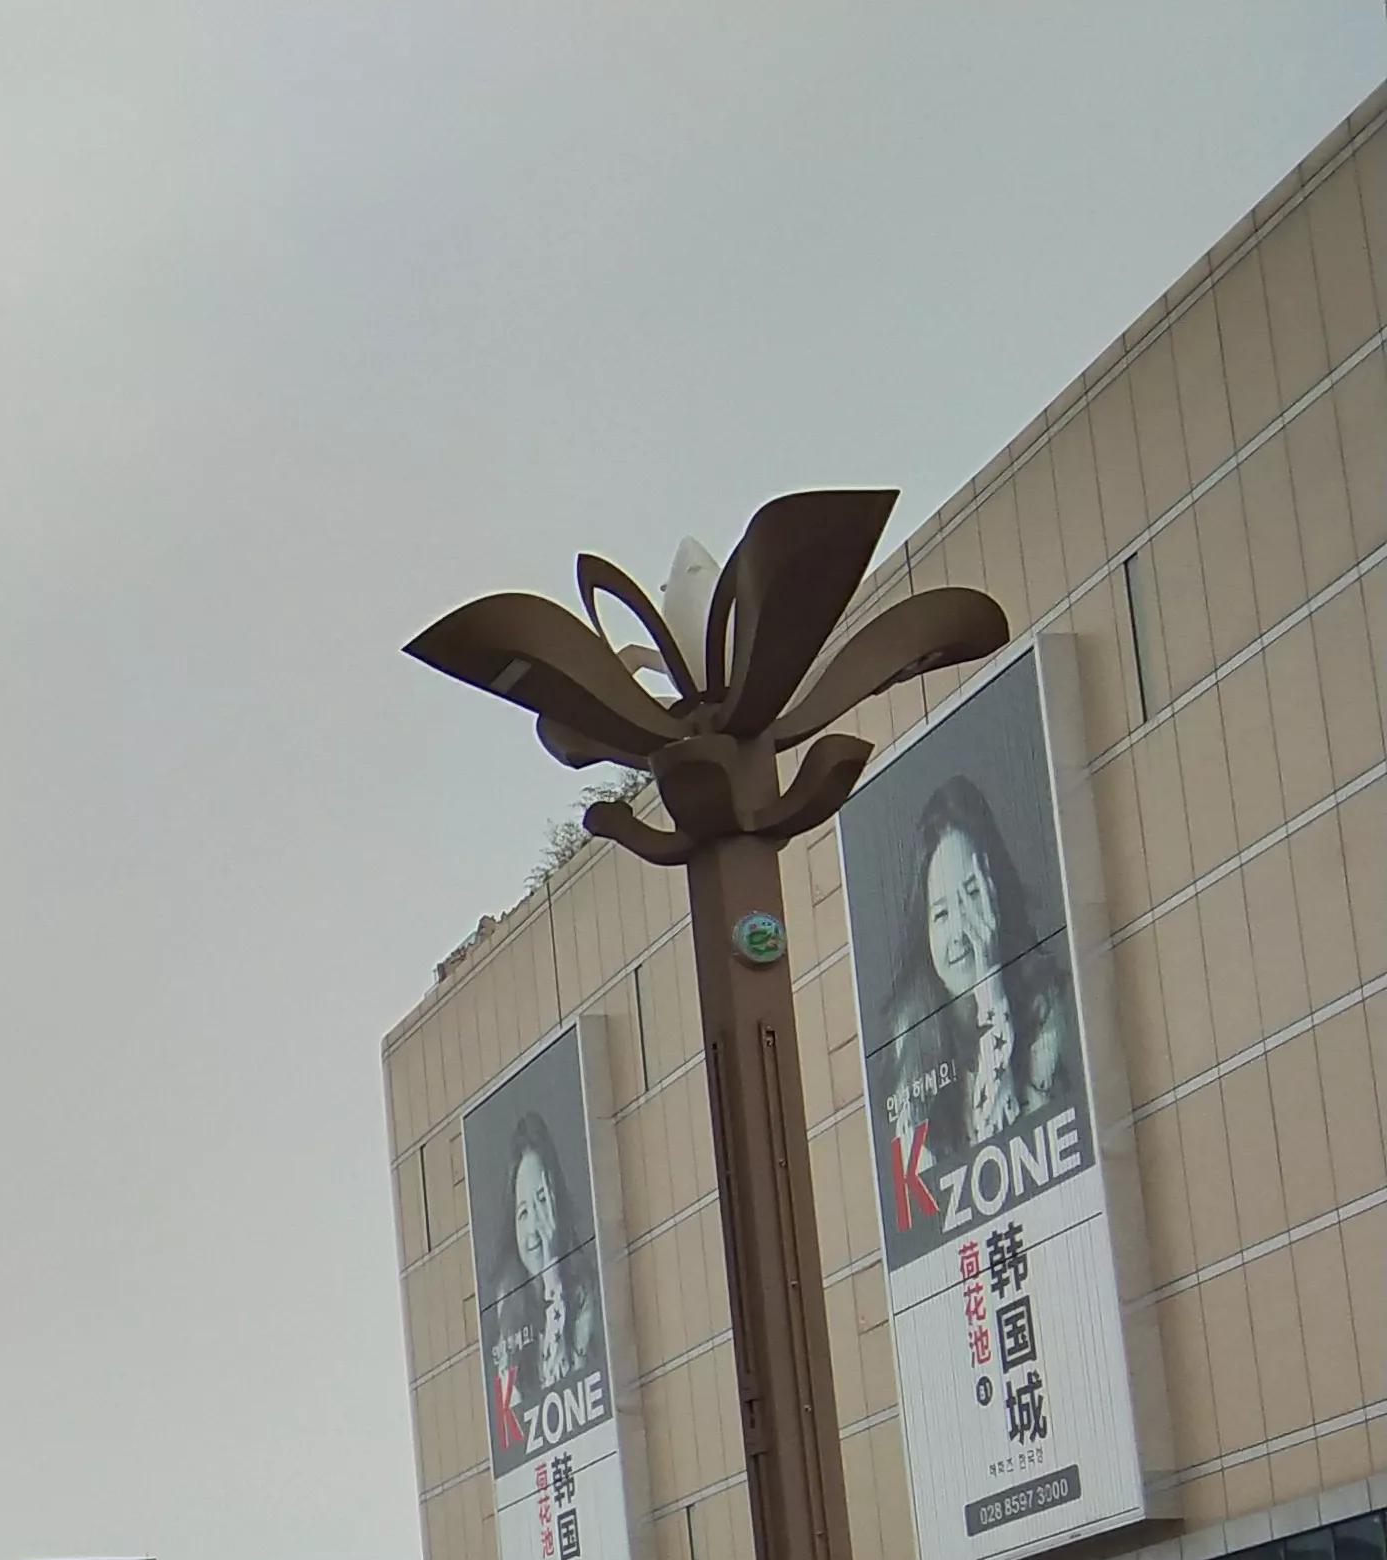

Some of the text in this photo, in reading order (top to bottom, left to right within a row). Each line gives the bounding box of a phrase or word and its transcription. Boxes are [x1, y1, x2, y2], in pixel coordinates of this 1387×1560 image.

[958, 1240, 992, 1369] 荷花池
[986, 1221, 1048, 1446] 韩国城
[534, 1463, 555, 1559] 荷花池
[979, 1478, 1069, 1525] 028 8597 3000
